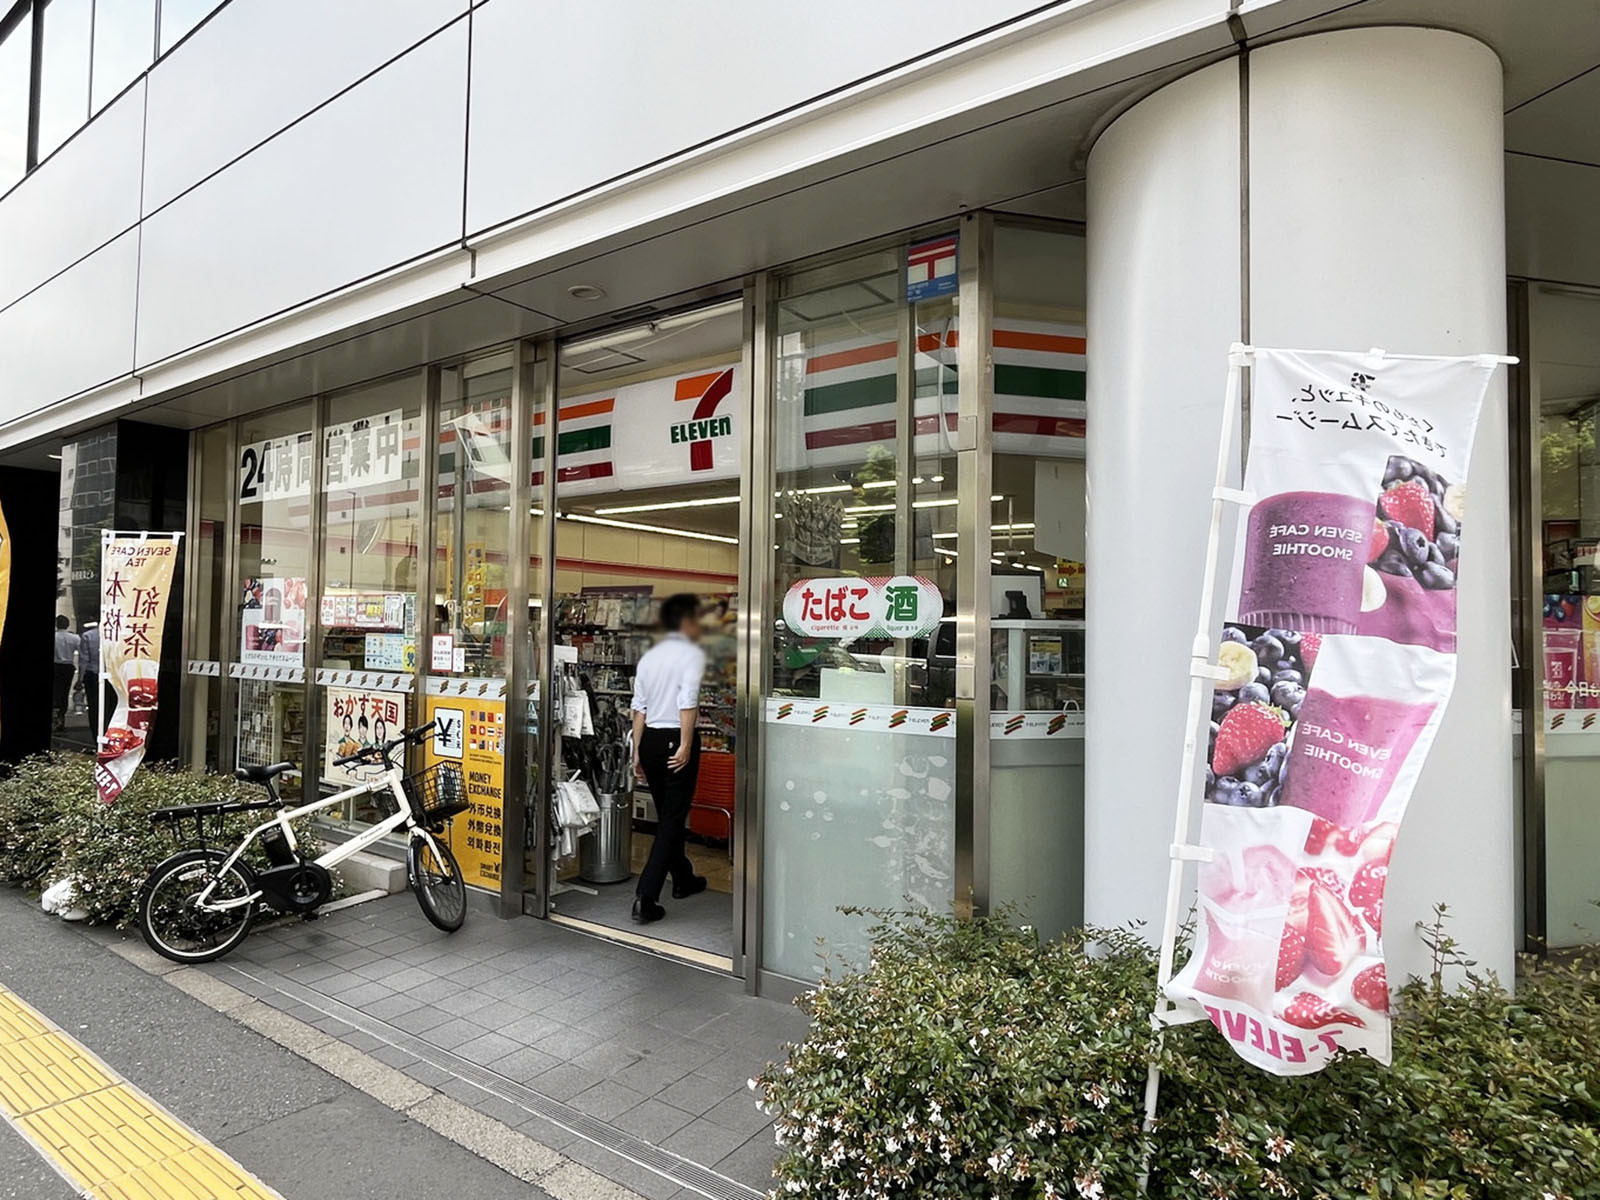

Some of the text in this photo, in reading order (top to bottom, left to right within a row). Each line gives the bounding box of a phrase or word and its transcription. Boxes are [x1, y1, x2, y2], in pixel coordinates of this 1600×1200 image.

[674, 367, 734, 472] 7
[801, 585, 870, 622] たばこ
[885, 585, 919, 622] 酒
[333, 694, 399, 726] おかず天国
[468, 771, 492, 785] MONEY
[468, 783, 502, 800] EXCHANGE
[469, 802, 502, 821] 外币兑换
[466, 836, 501, 856] 외화환전
